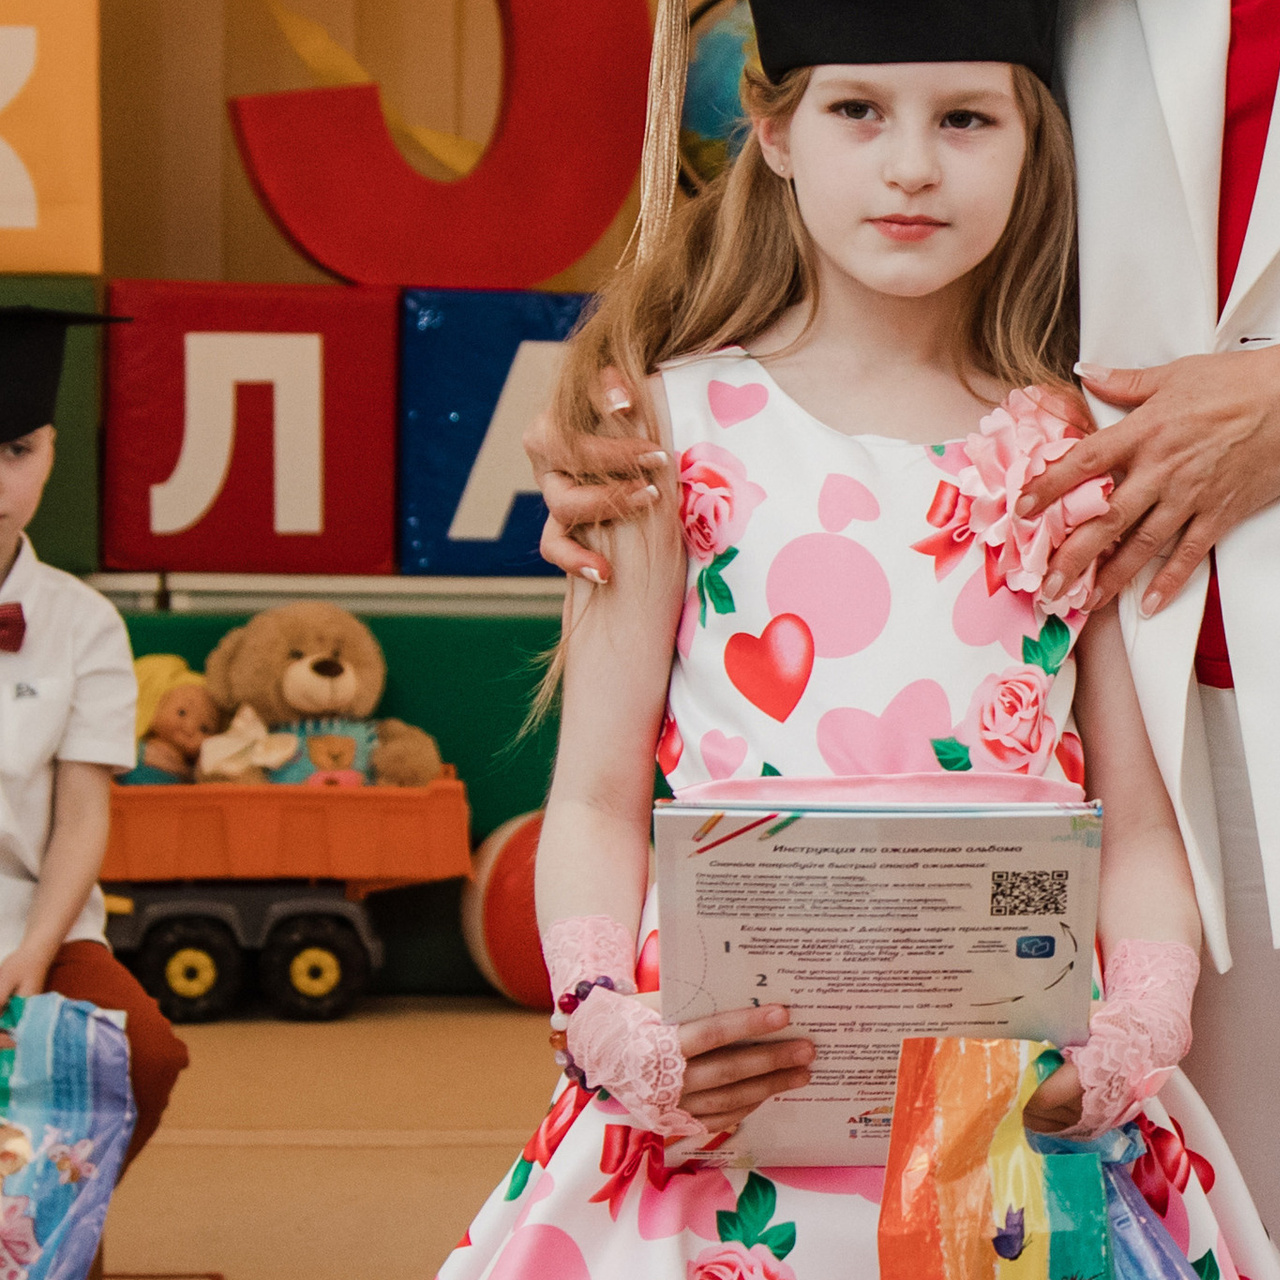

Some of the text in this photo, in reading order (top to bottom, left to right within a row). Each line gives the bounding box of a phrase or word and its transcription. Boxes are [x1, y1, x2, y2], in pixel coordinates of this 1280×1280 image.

[774, 845, 856, 855] Инструкция
[966, 845, 1022, 853] альбома
[758, 861, 824, 870] попробуйте
[828, 862, 876, 870] быстрый
[786, 925, 854, 934] получилось?
[858, 925, 922, 934] Действуем
[756, 974, 768, 986] 2
